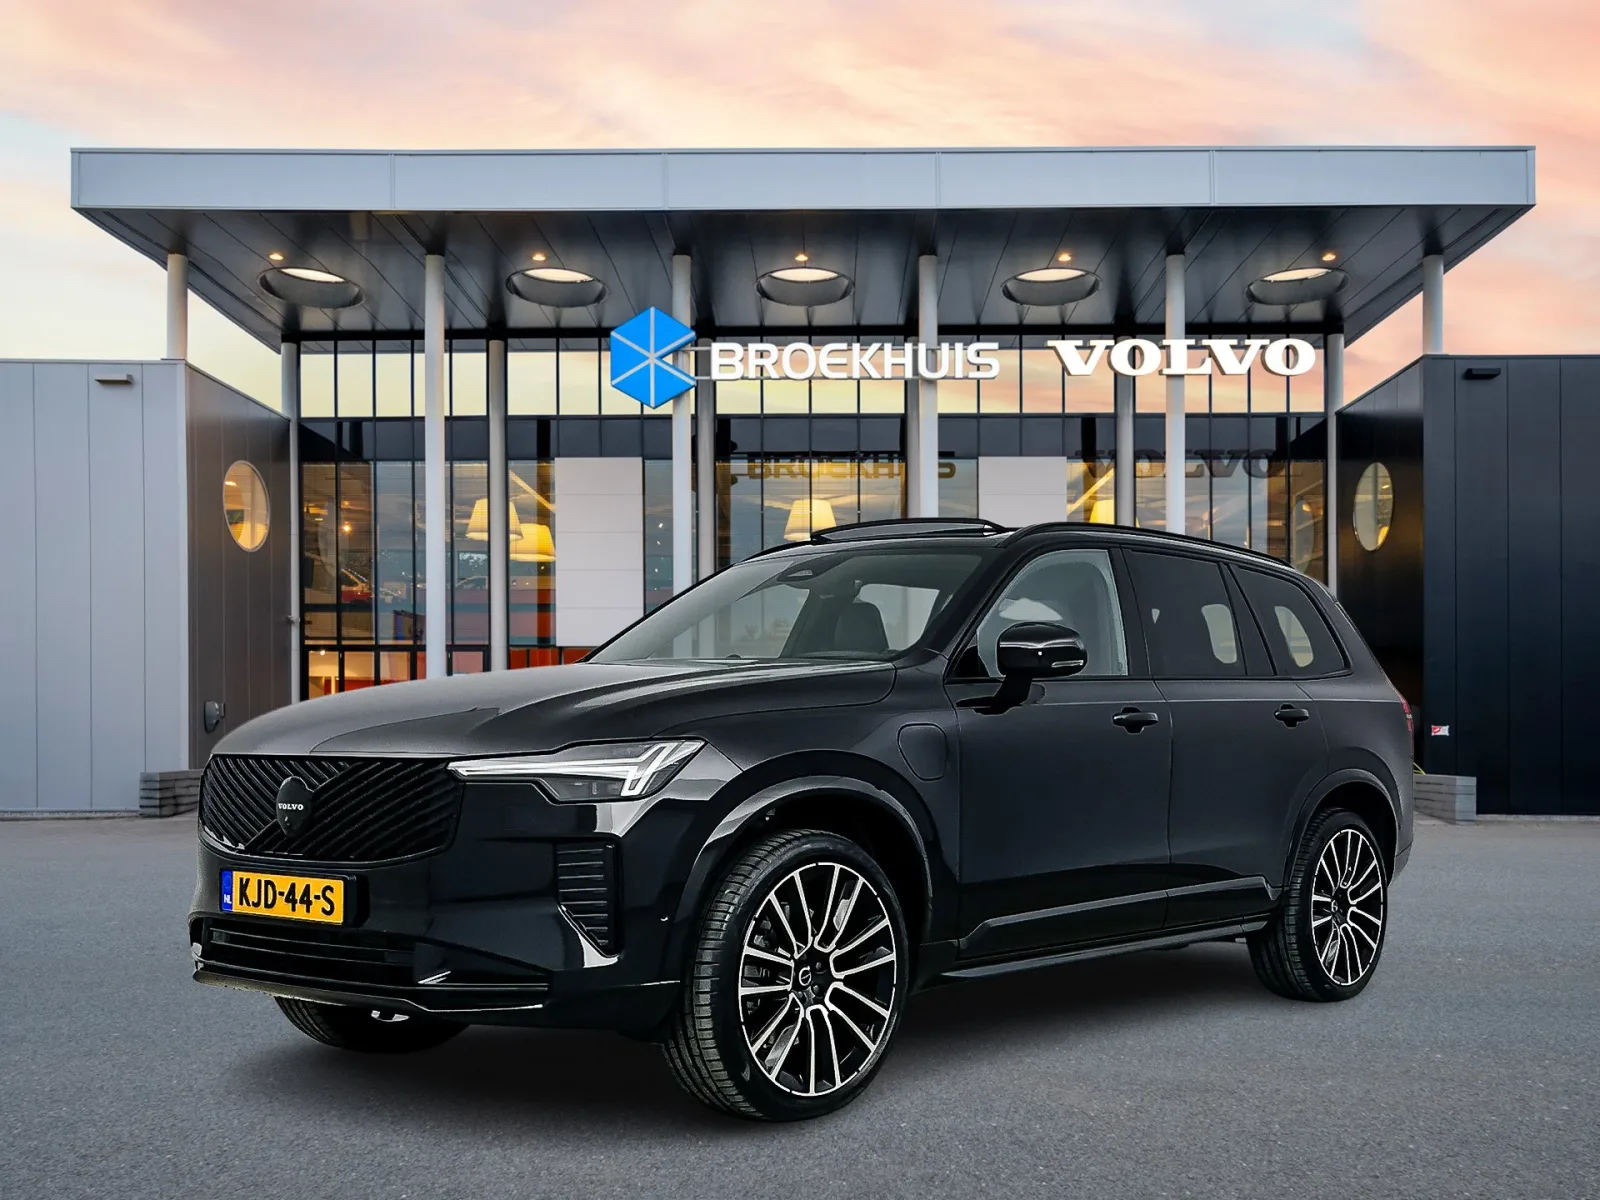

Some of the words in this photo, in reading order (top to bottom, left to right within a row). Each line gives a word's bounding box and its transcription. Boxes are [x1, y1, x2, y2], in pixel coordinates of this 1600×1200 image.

[711, 342, 1000, 379] BROEKHUIS
[1047, 338, 1316, 376] VOLVO
[278, 802, 304, 811] VOLVO
[223, 893, 232, 905] NL
[238, 877, 335, 916] KJD-44-S
